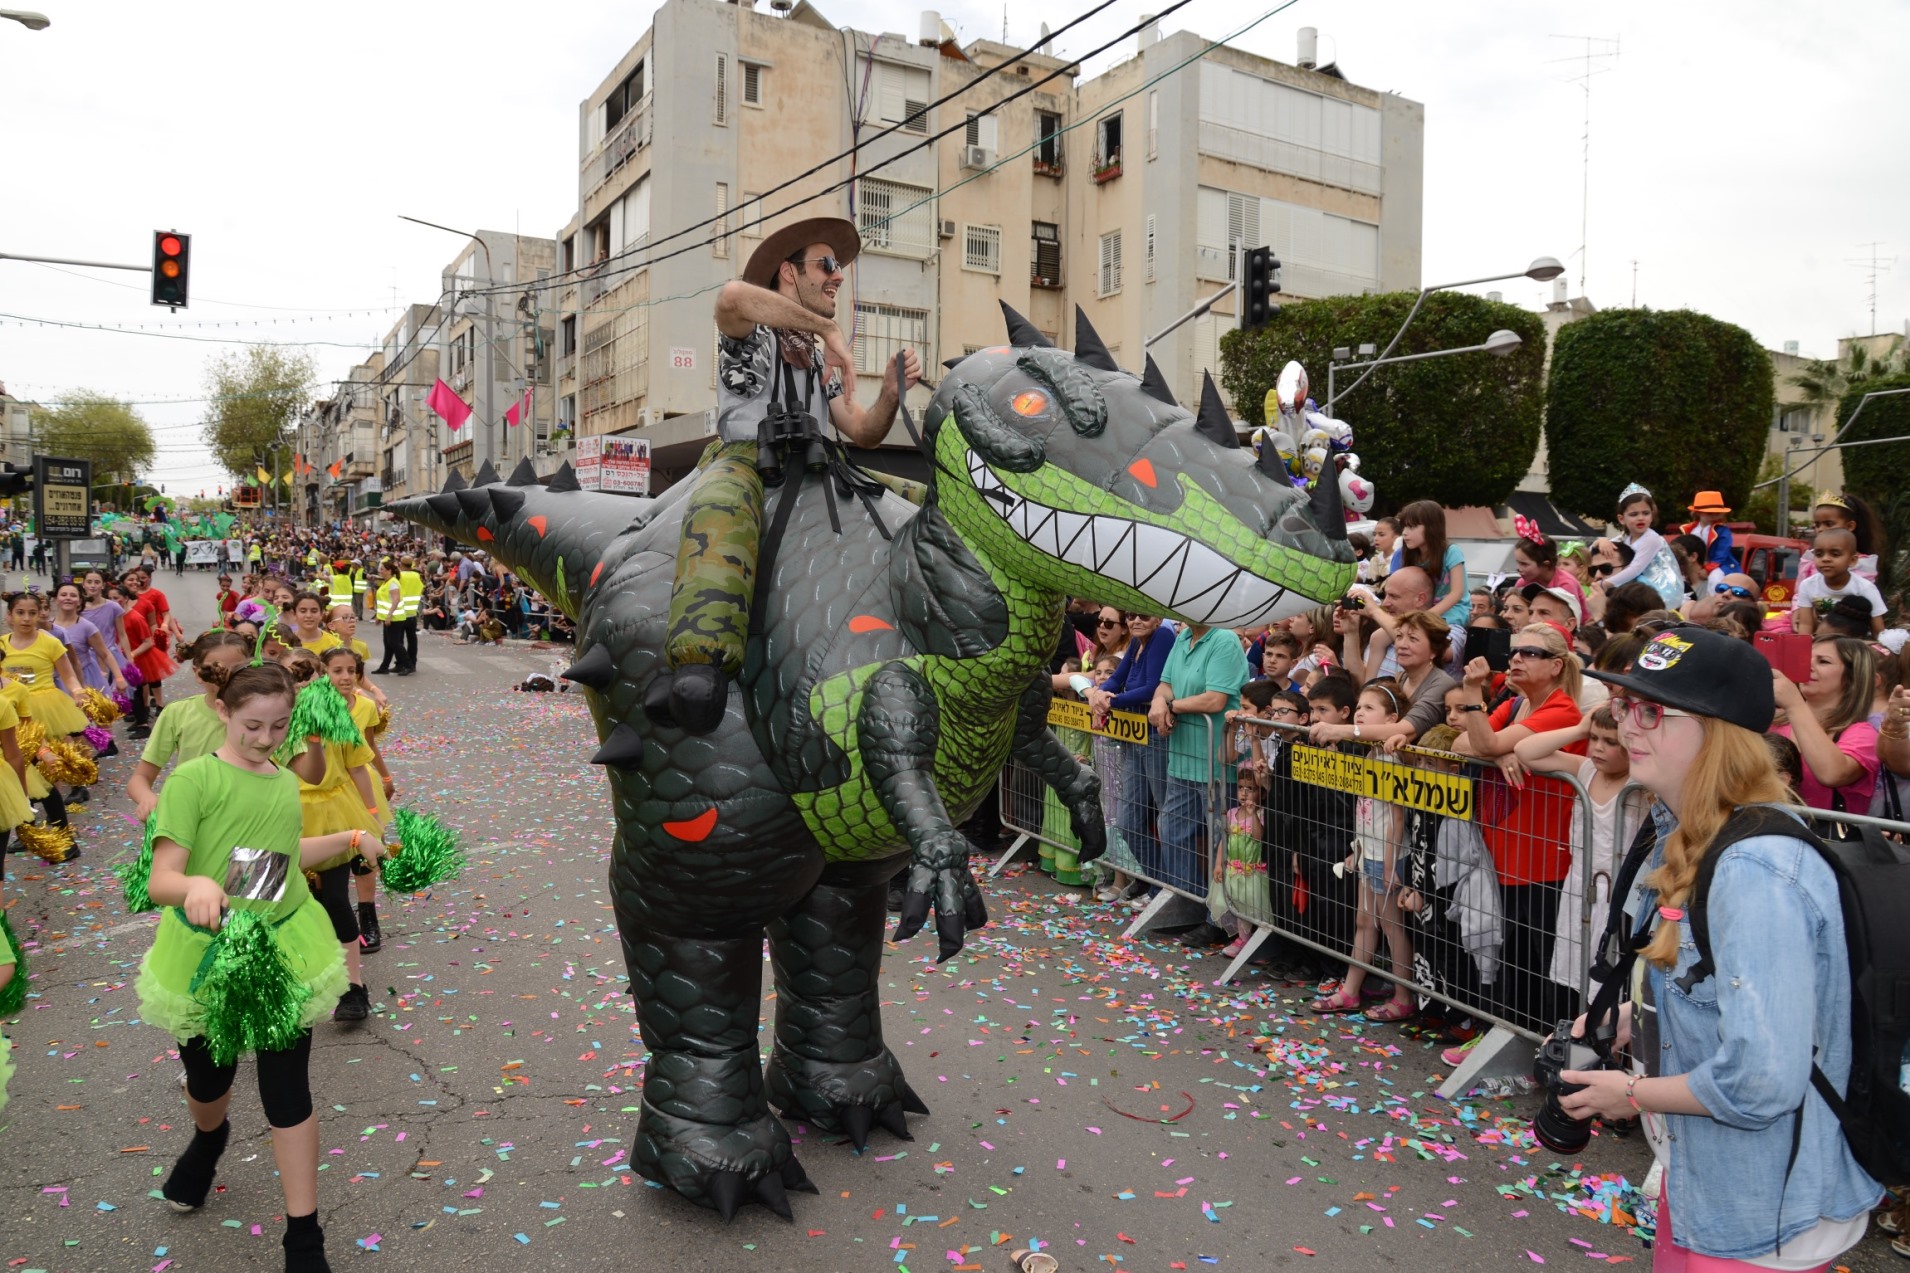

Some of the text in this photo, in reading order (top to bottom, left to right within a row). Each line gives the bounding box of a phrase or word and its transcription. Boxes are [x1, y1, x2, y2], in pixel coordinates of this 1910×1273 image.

[674, 356, 693, 368] 88
[612, 479, 645, 487] 03-600780
[1049, 701, 1069, 713] לאירוע
[1086, 709, 1146, 741] שמלאר
[1293, 750, 1362, 776] ציוד לאירועים
